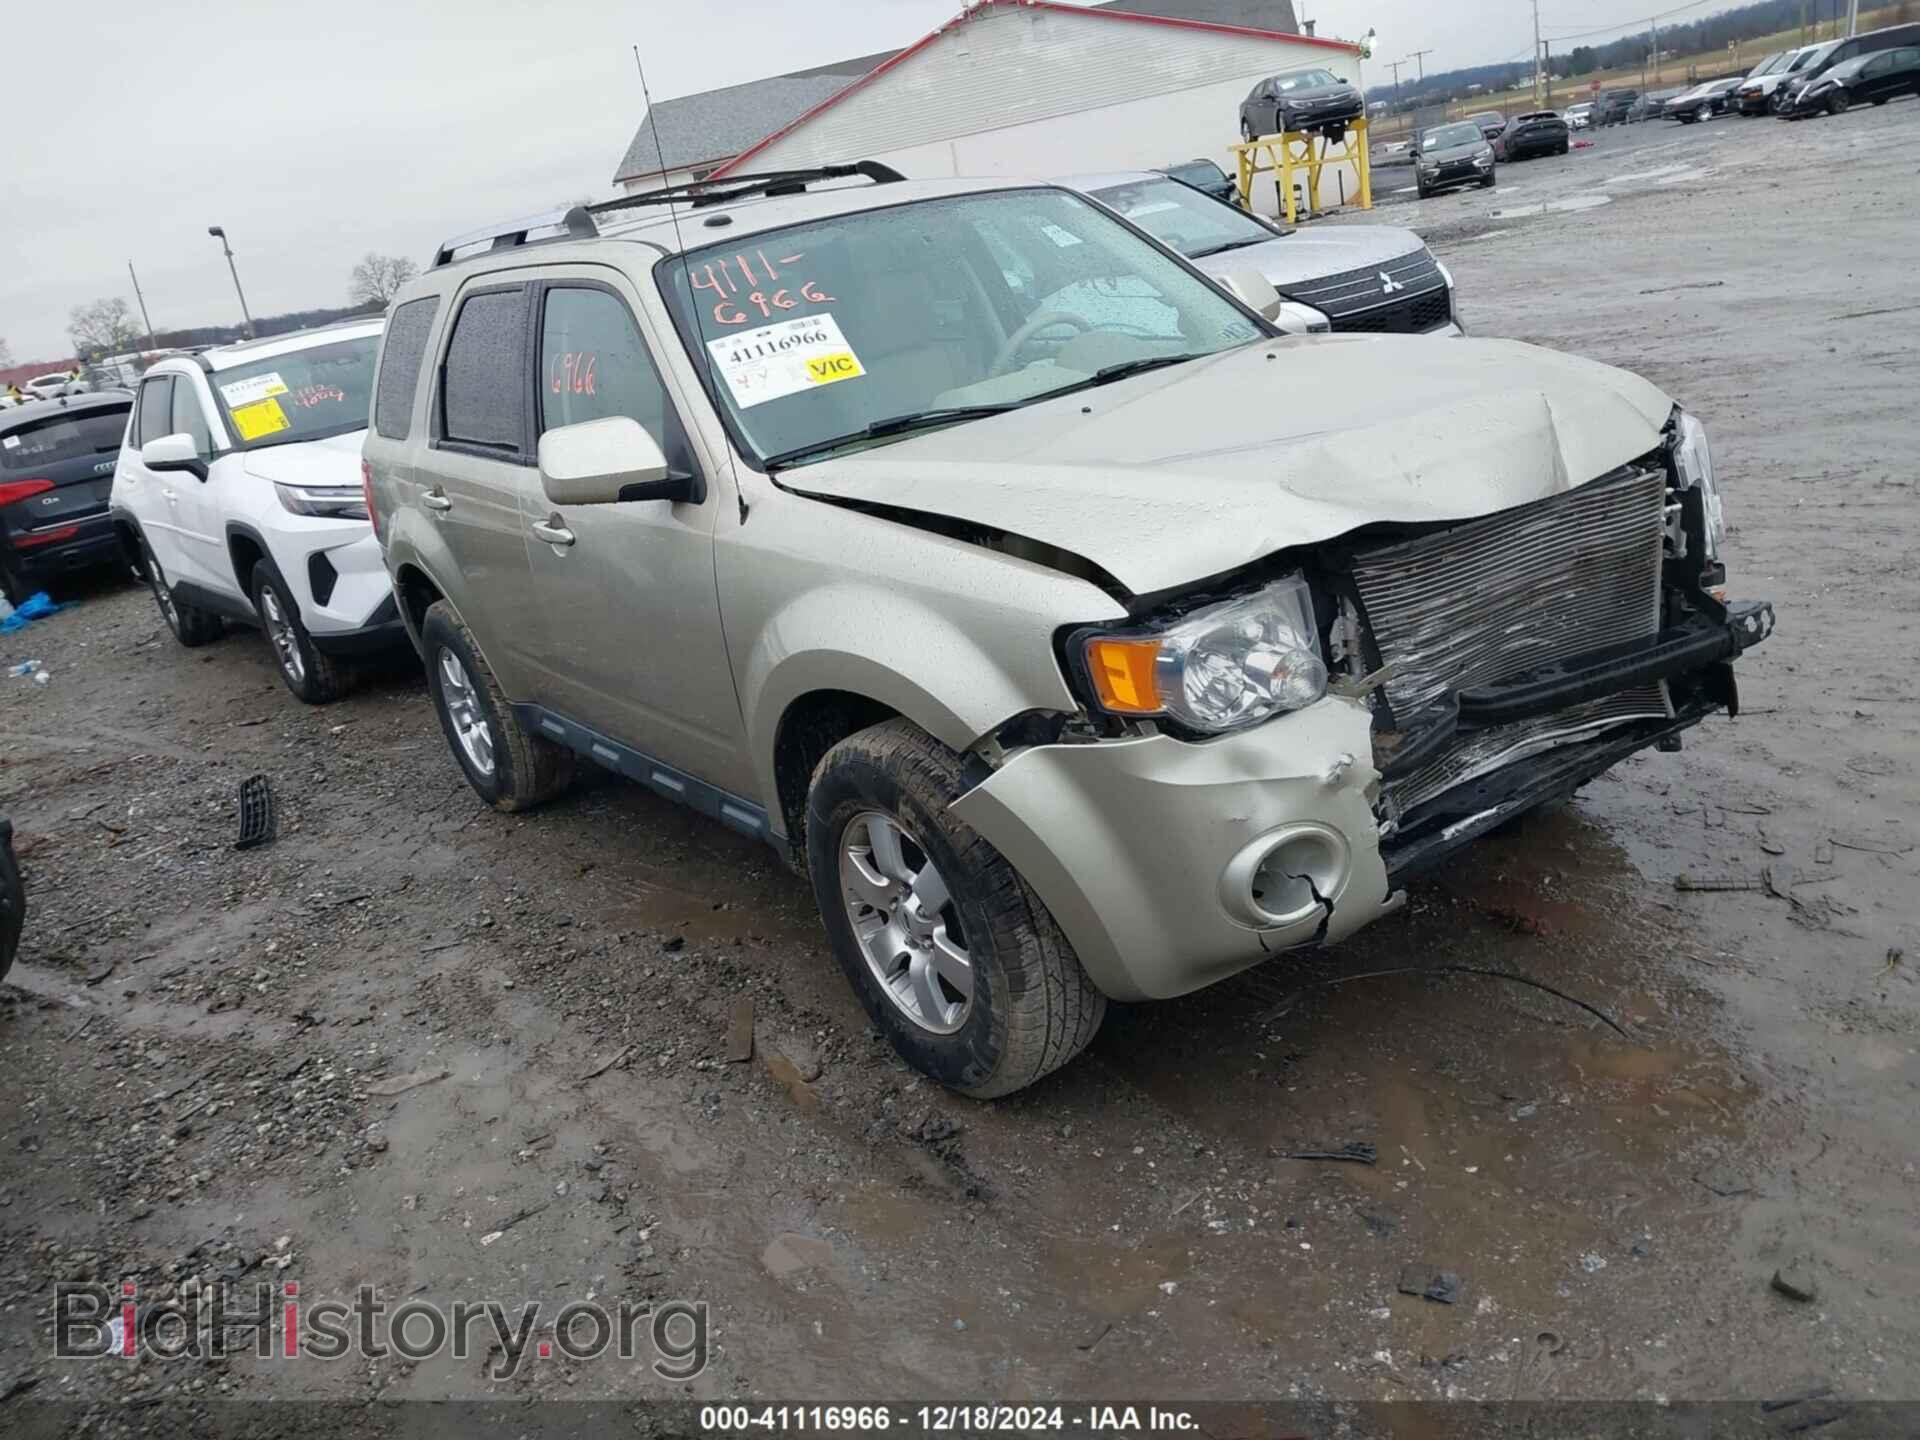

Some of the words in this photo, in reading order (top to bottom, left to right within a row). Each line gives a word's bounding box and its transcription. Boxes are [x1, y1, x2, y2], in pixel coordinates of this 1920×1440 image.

[712, 281, 836, 324] 6966
[730, 329, 829, 365] 41116966
[551, 351, 596, 395] 6966
[810, 357, 854, 377] VIC
